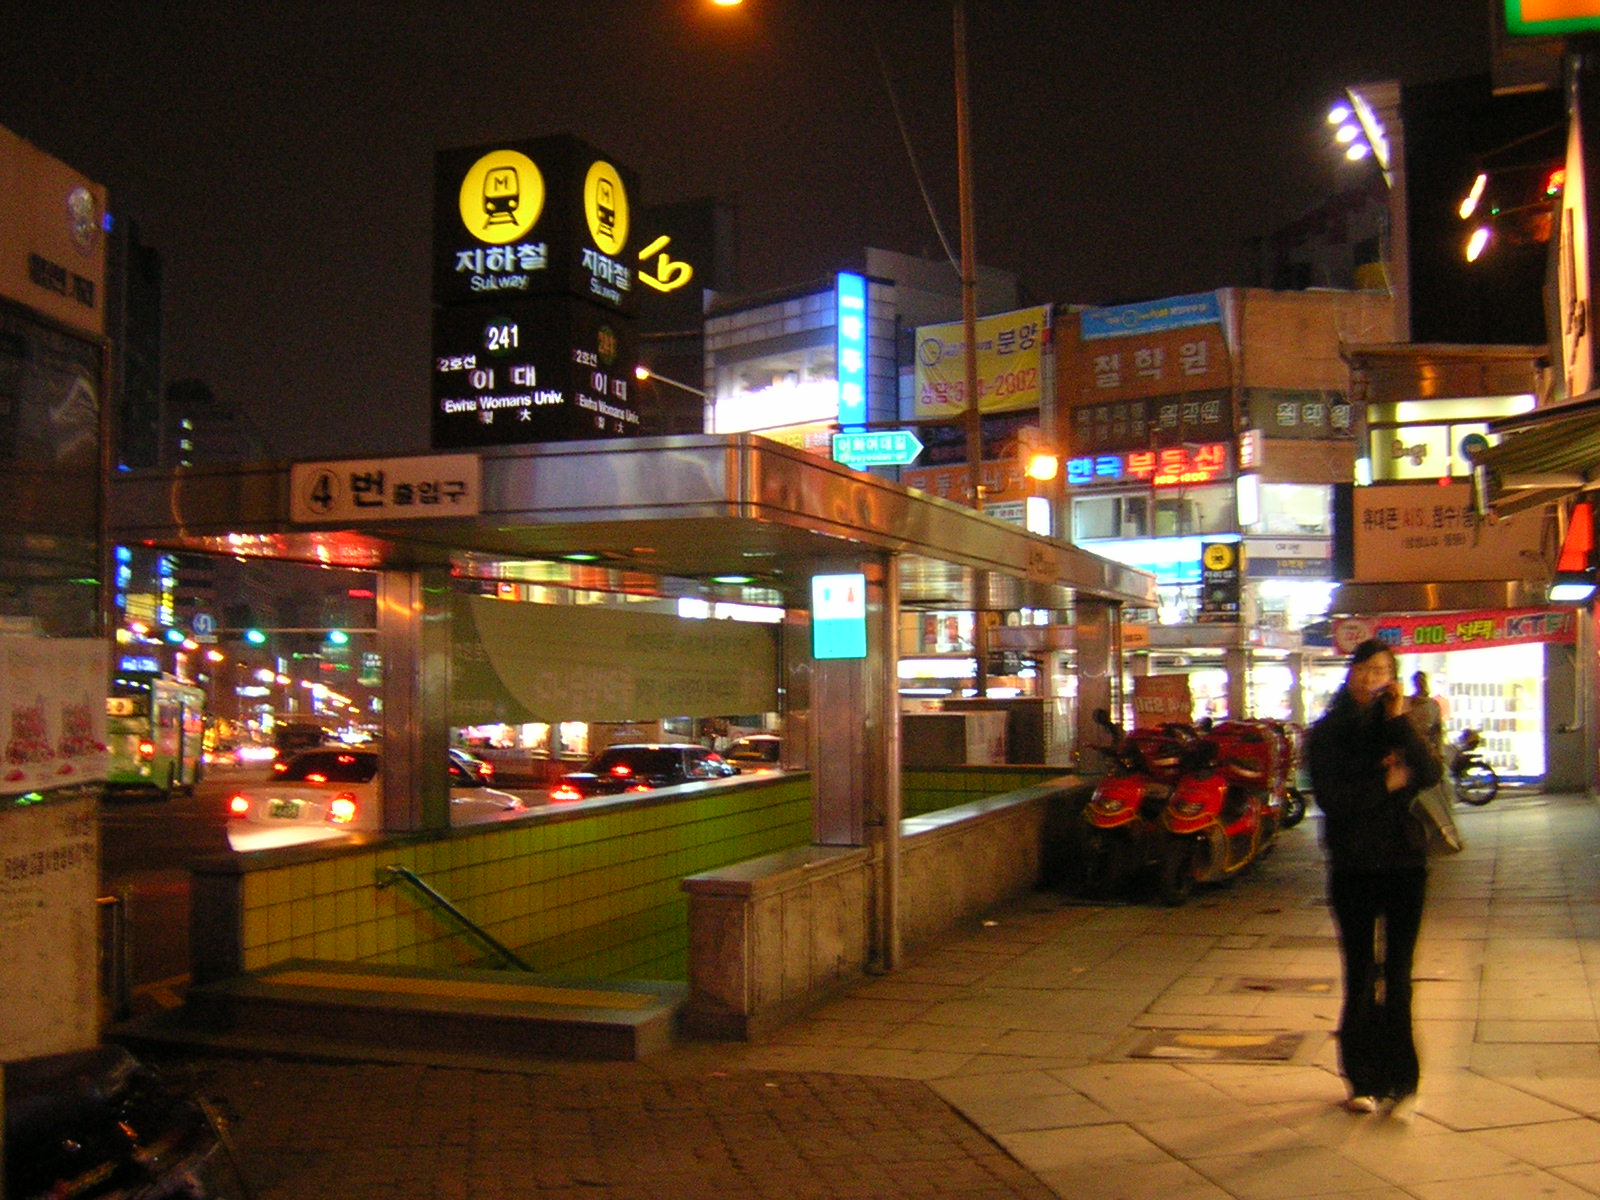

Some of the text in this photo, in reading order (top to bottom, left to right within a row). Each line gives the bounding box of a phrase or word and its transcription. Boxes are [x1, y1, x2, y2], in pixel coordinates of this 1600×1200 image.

[455, 242, 549, 274] 지하철
[581, 247, 632, 291] 지하철
[487, 324, 520, 351] 241
[997, 323, 1039, 355] 분양
[440, 354, 477, 372] 2호선
[445, 389, 565, 414] Ewha Womans Univ.
[1066, 454, 1123, 485] 한국
[1127, 443, 1226, 477] 부동산
[393, 480, 466, 506] 출입구
